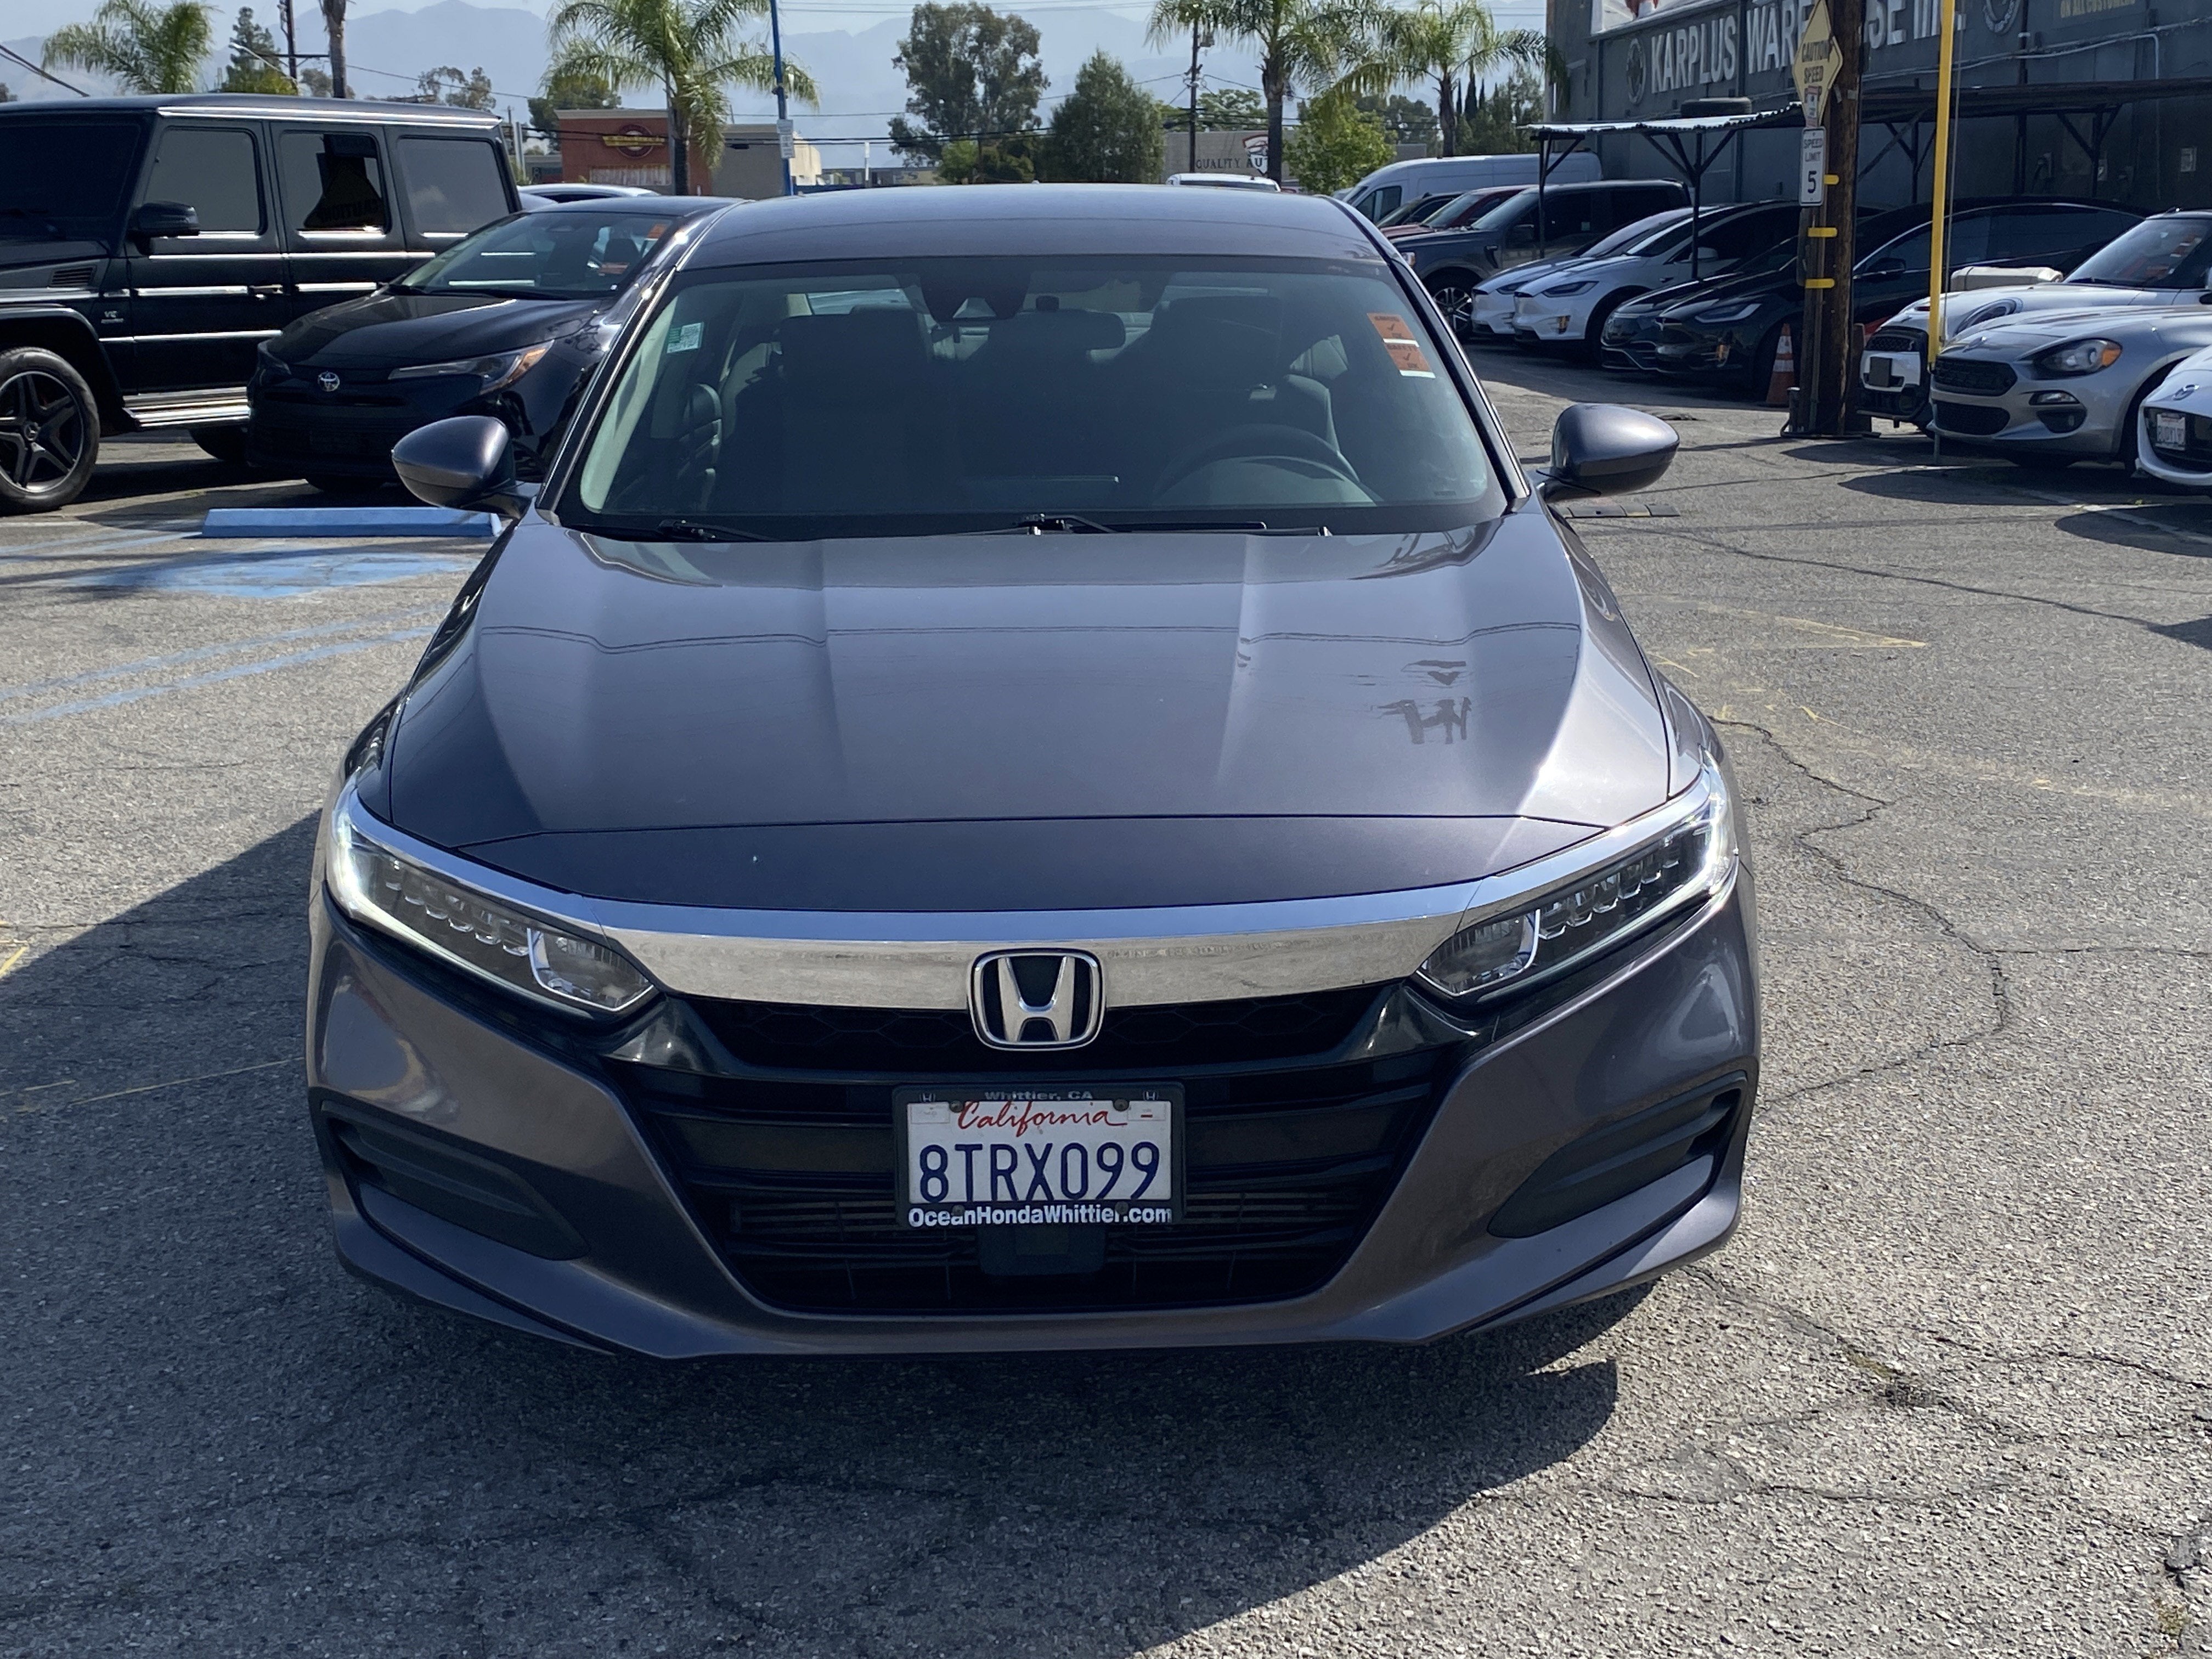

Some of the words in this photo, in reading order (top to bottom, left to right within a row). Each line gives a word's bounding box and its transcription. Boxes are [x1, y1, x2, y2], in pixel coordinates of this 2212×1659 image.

[1651, 15, 1737, 94] KARPLUS
[1802, 38, 1831, 63] CAUTION
[1804, 65, 1824, 84] SPEED
[1804, 138, 1824, 149] SPEED
[1195, 157, 1240, 170] QUALITY
[1804, 151, 1822, 162] LIMIT
[1807, 170, 1818, 194] 5
[984, 1091, 1062, 1101] Whittier,
[1068, 1091, 1093, 1100] CA
[958, 1100, 1128, 1137] California
[919, 1142, 1160, 1203] 8TRX099
[908, 1204, 1172, 1227] OceanHondaWhittier.com
